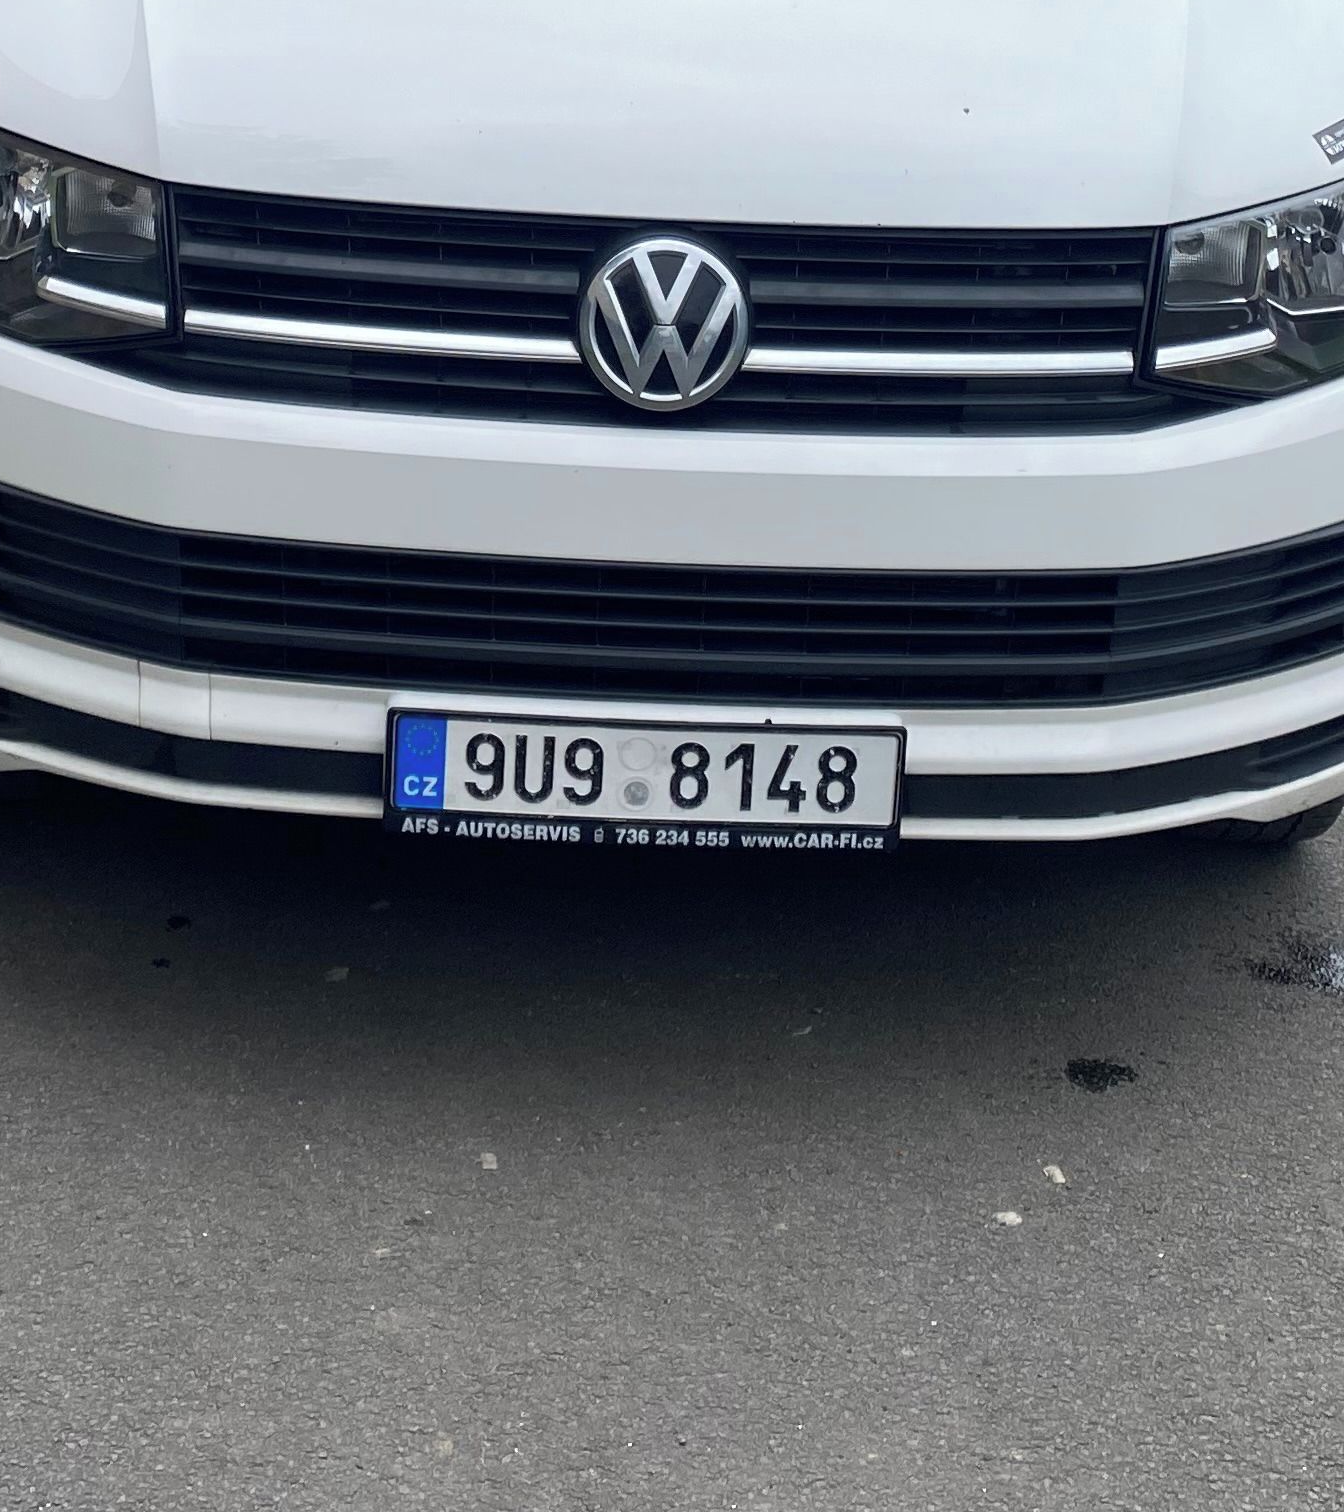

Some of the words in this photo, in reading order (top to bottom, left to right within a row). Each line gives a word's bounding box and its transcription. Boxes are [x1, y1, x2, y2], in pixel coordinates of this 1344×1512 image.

[403, 775, 438, 797] CZ
[464, 732, 605, 806] 9U9
[669, 742, 859, 814] 8148
[401, 817, 439, 835] AFS
[455, 820, 581, 843] AUTOSERVIS
[615, 828, 650, 845] 736
[655, 829, 690, 846] 234
[694, 831, 730, 847] 555
